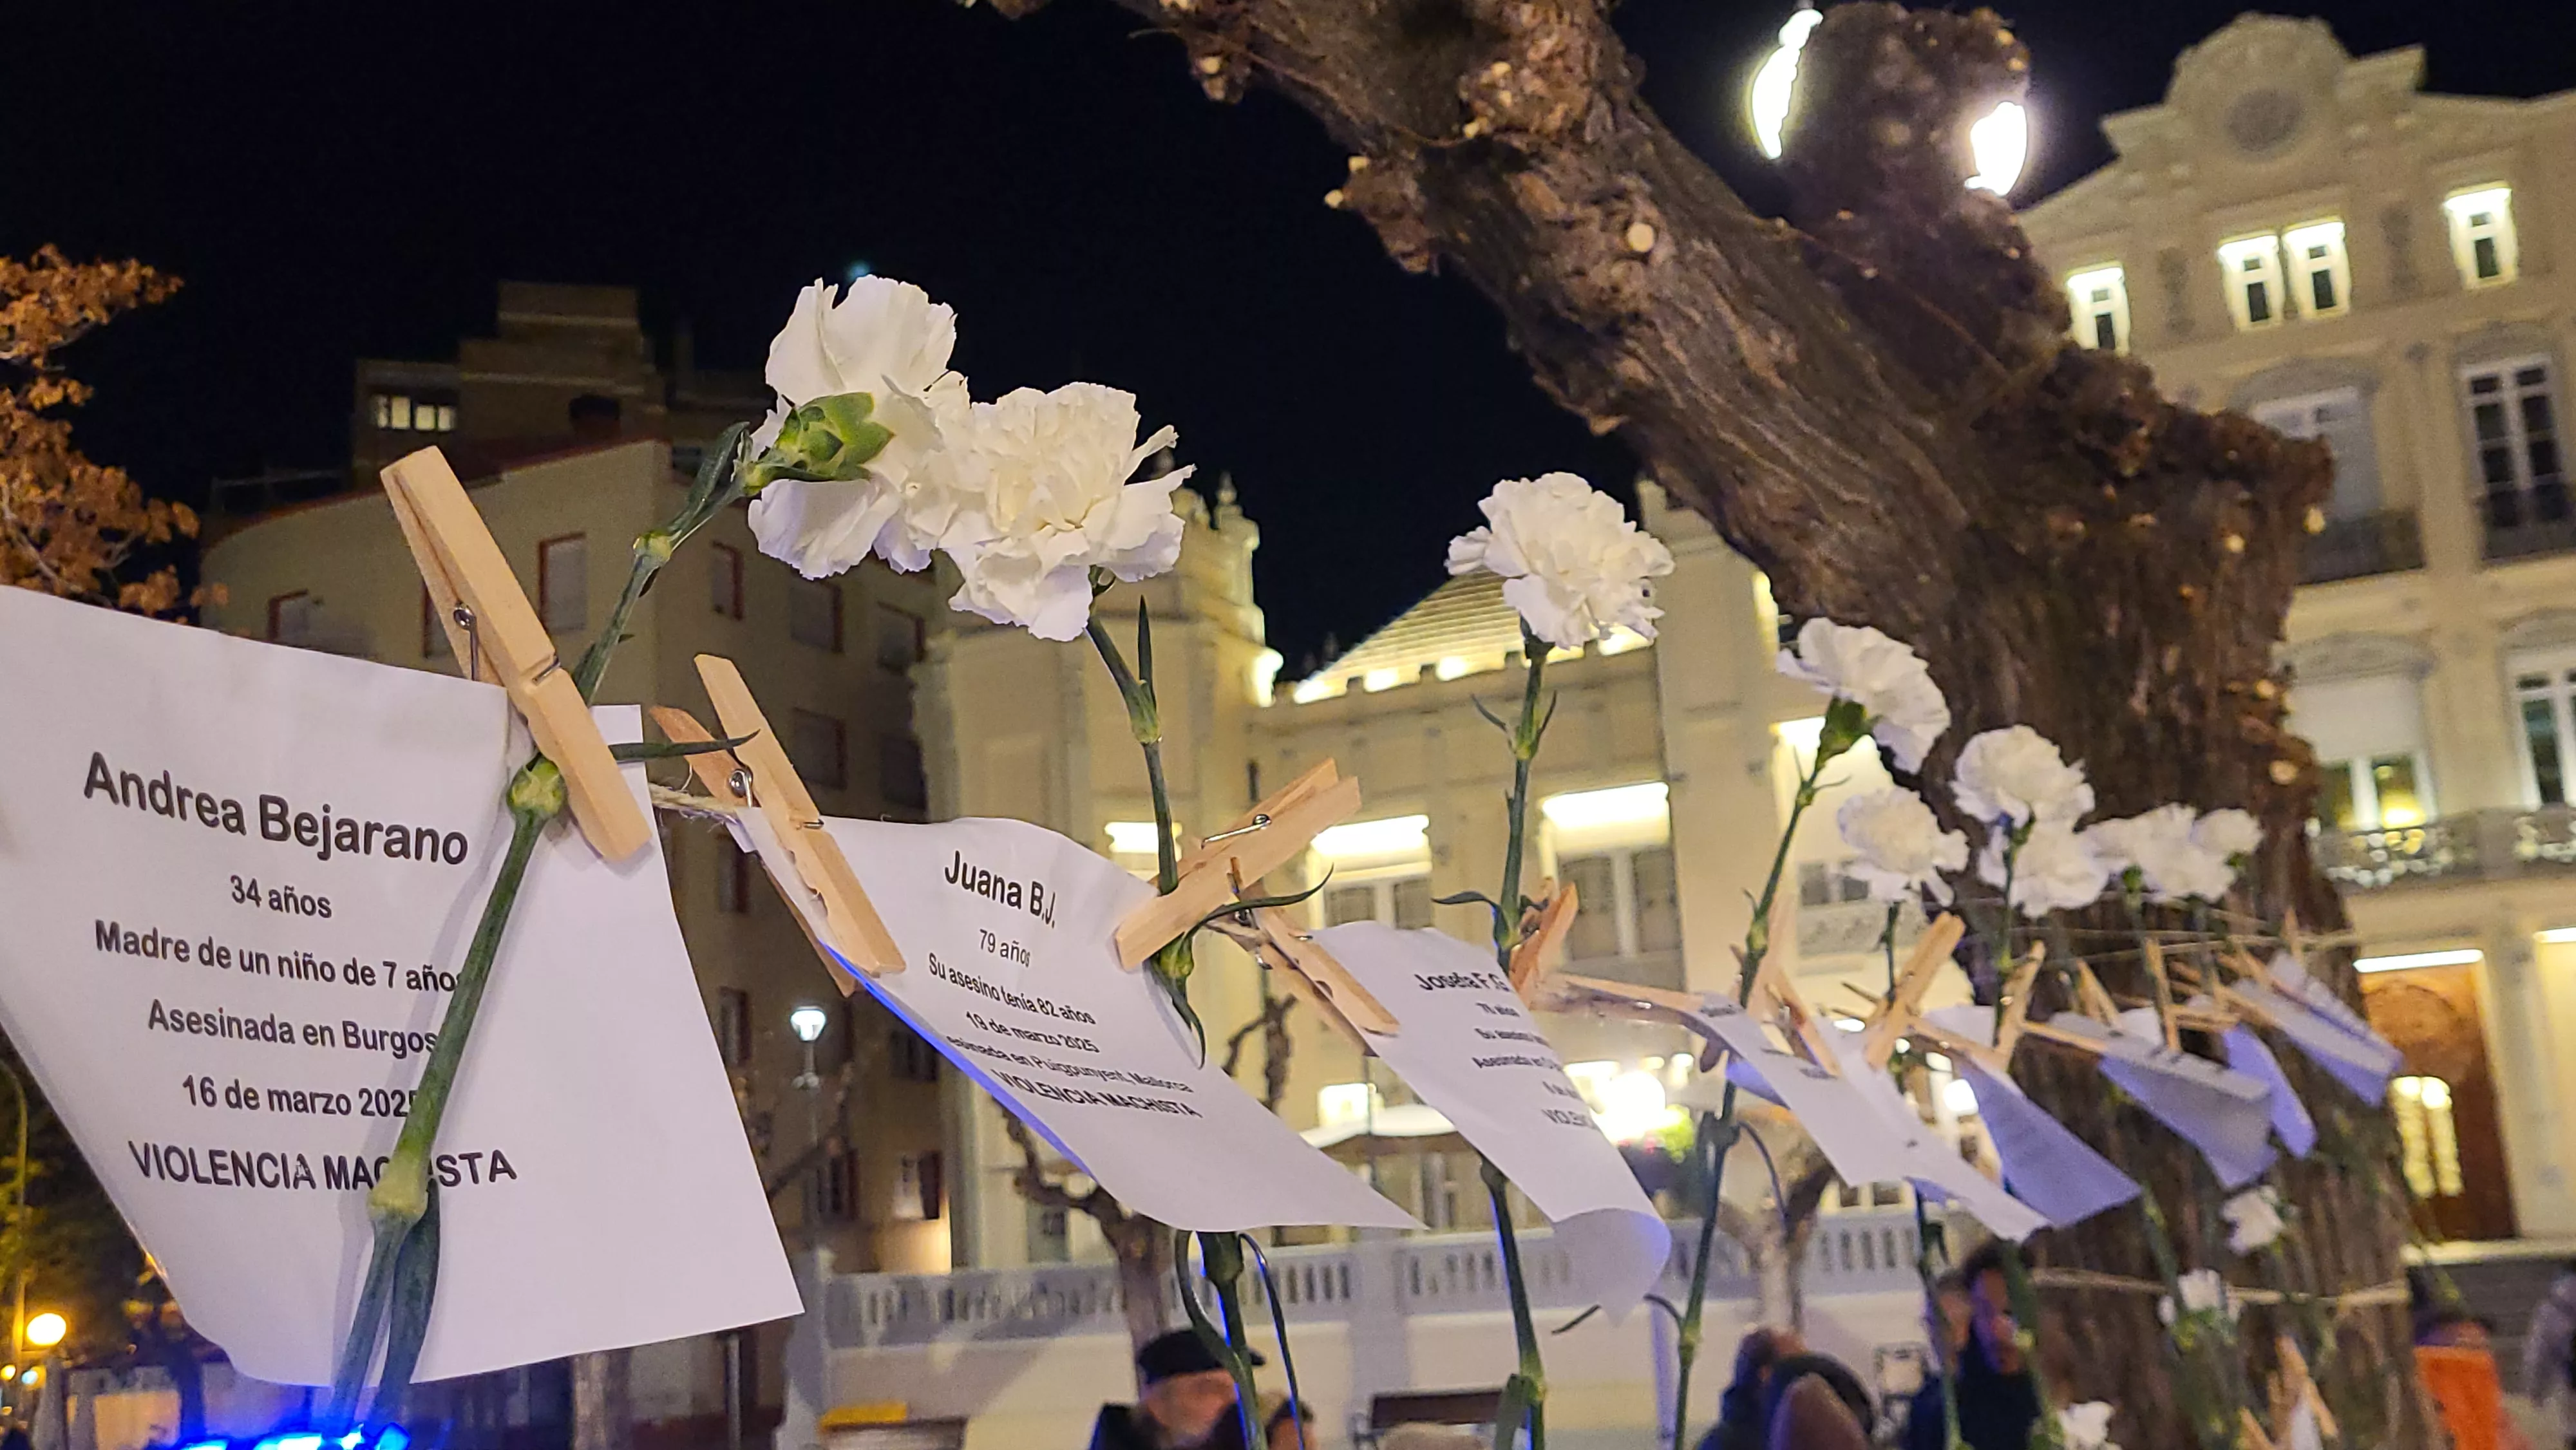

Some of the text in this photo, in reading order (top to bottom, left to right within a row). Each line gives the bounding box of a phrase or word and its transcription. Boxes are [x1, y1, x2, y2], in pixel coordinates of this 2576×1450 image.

[84, 751, 469, 865] Andrea Bejarano
[230, 874, 333, 919] 34 años
[944, 850, 1056, 929] Juana B.J.
[95, 919, 462, 993] Madre de un niño de 7 año
[979, 928, 1031, 968] 79 años
[929, 952, 947, 981] Su
[949, 967, 1001, 1002] asesino
[1036, 997, 1059, 1018] 82
[1058, 1004, 1097, 1025] años
[148, 999, 295, 1046] Asesinada
[303, 1024, 336, 1048] en
[965, 1010, 1100, 1053] 19 de marzo 2025
[1010, 1053, 1035, 1068] en
[182, 1075, 216, 1107] 16
[225, 1080, 260, 1110] de
[267, 1088, 352, 1115] marzo
[990, 1068, 1204, 1119] VIOLENCIA MACHISTA
[128, 1140, 316, 1189] VIOLENCIA
